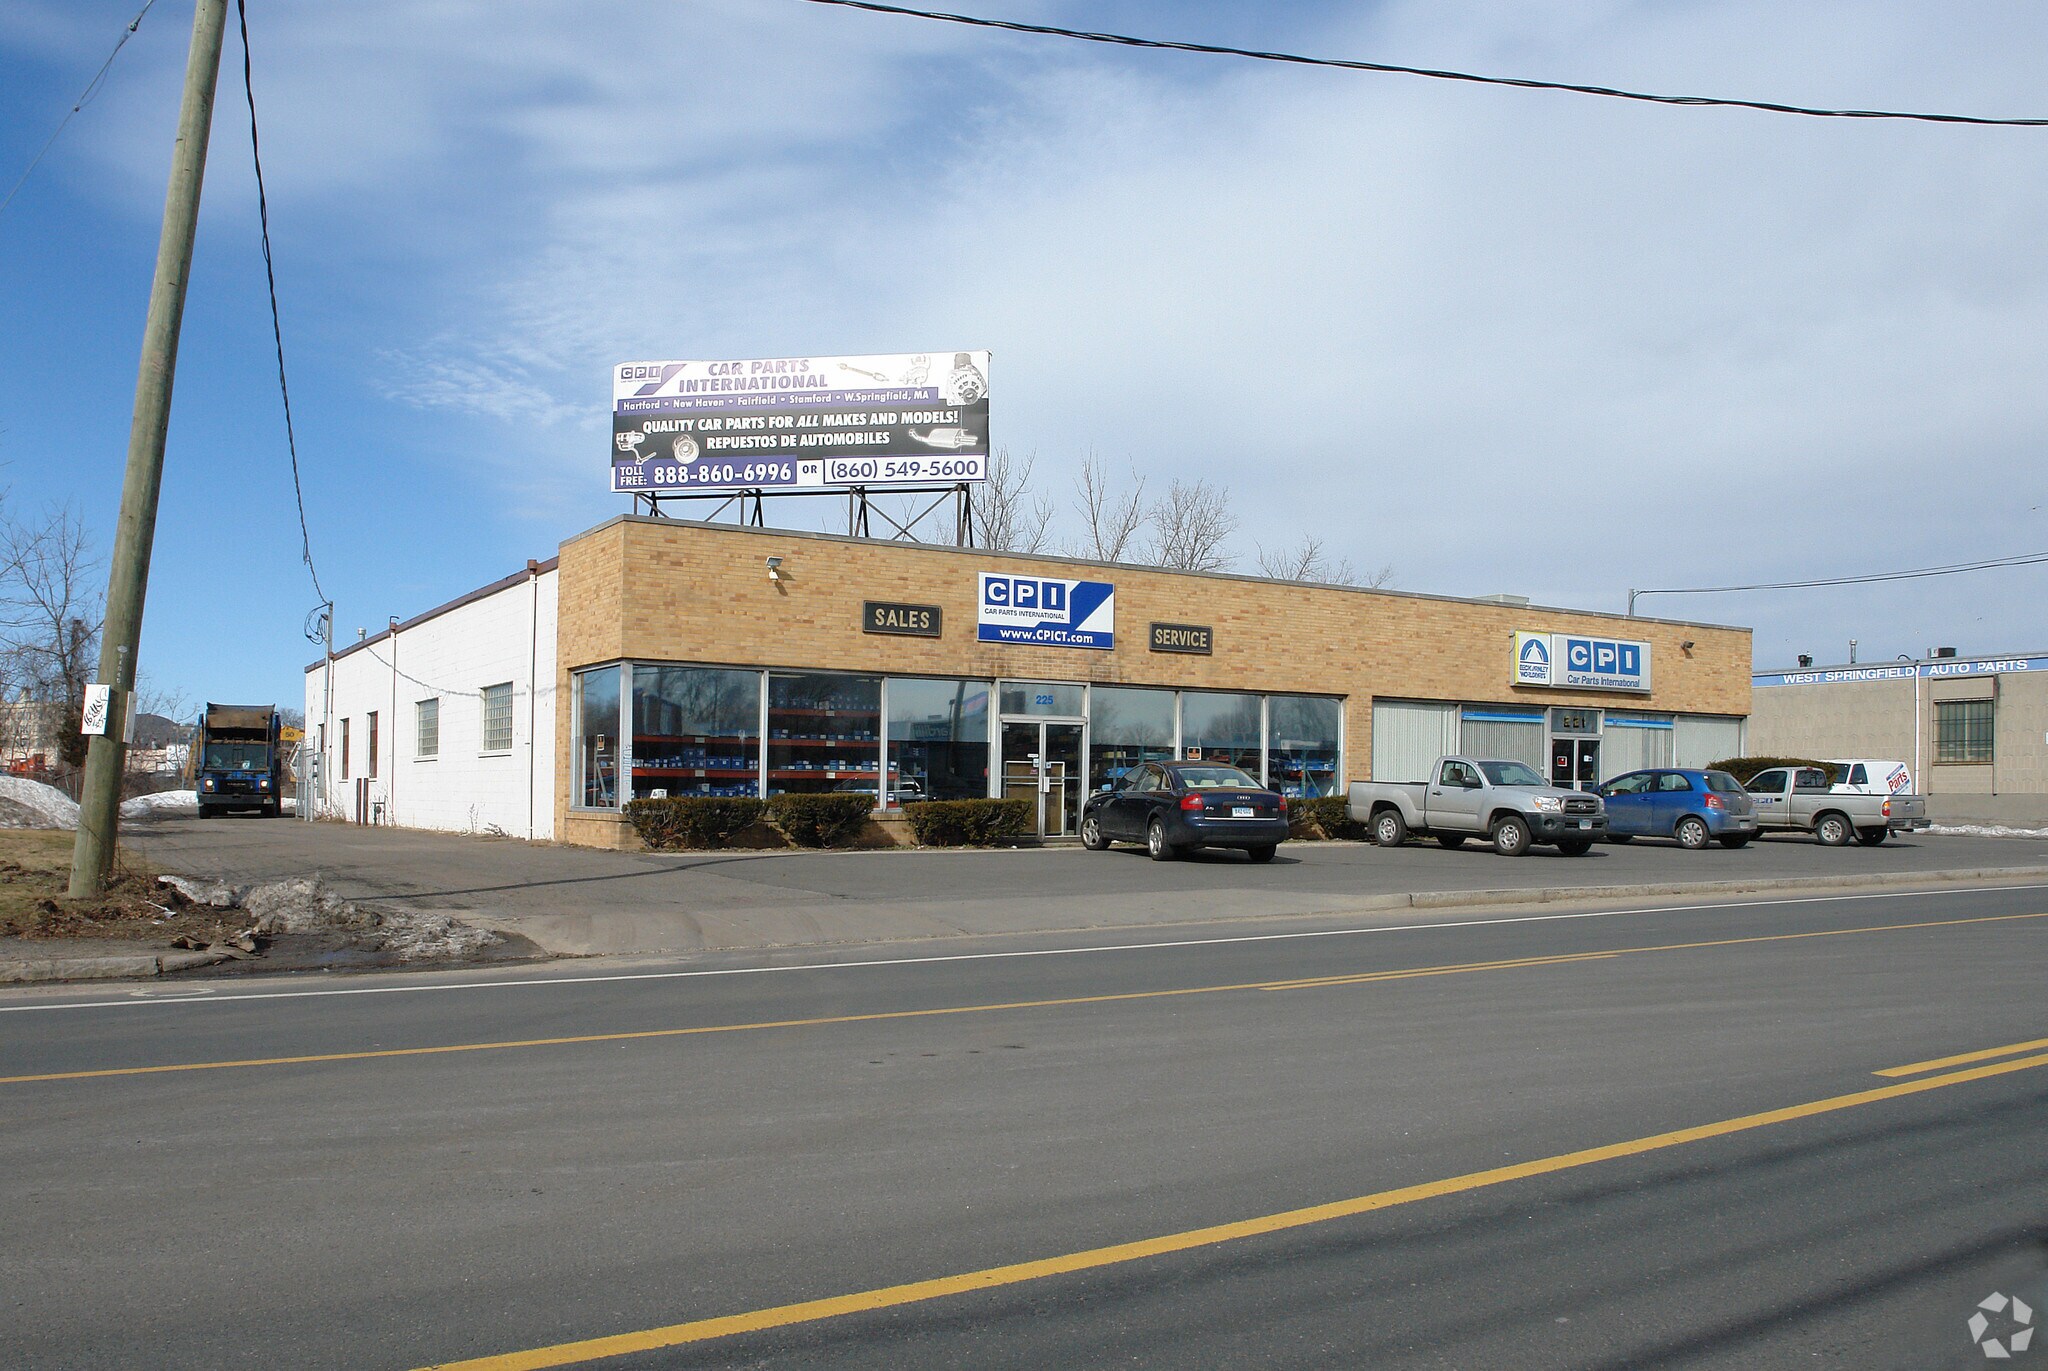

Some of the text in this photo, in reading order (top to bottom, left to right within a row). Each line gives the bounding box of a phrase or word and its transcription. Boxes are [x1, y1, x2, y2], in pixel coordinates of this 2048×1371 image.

[621, 366, 659, 379] CPI
[708, 359, 810, 376] CAR PARTS
[679, 374, 828, 393] INTERNATIONAL
[623, 390, 929, 411] Hartford New Haven Fairfield Stamford W.Springfield, MA
[642, 410, 959, 434] QUALITY CAR PARTS FOR ALL MAKES AND MODELS!
[706, 432, 890, 449] REPUESTOS DE AUTOMOBILES
[620, 466, 645, 476] TOLL
[654, 459, 979, 484] 888-860-6996 OR (860) 549-5600
[620, 476, 648, 486] FREE:
[987, 580, 1059, 607] CPI
[874, 607, 931, 628] SALES
[984, 607, 1065, 620] CAR PARTS INTERNATIONAL
[999, 629, 1093, 644] www.CPICT.com
[1154, 628, 1208, 648] SERVICE
[1570, 645, 1633, 669] CPI
[1567, 674, 1640, 688] Car Parts International
[1782, 659, 2028, 684] WEST SPRINGFIELD AUTO PARTS
[1035, 695, 1054, 705] 225
[1887, 771, 1908, 792] Parts
